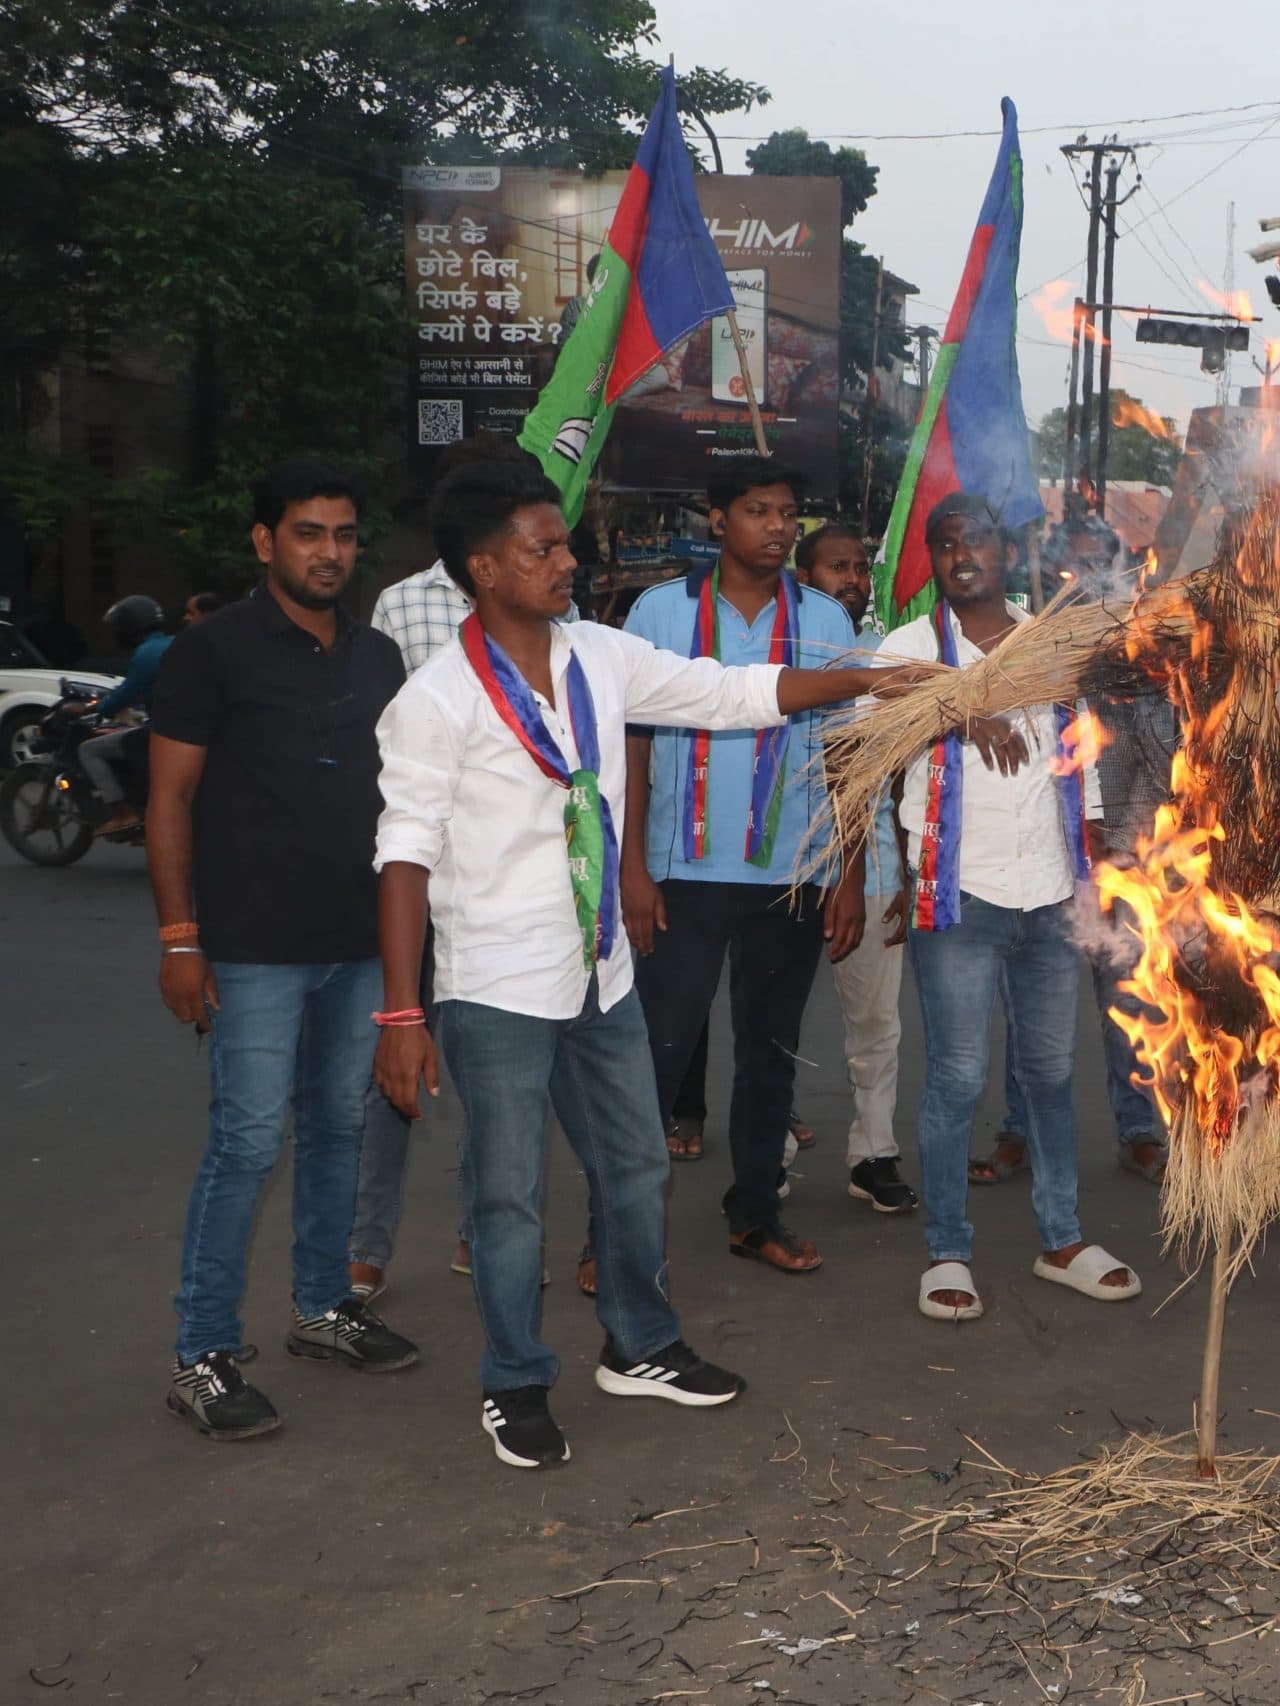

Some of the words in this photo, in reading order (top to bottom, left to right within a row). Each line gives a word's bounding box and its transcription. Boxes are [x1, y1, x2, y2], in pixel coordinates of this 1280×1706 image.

[416, 225, 452, 244] घर
[460, 218, 488, 244] के
[704, 218, 800, 249] HIM
[416, 250, 463, 277] छोटे
[471, 250, 528, 282] बिल,
[416, 282, 478, 309] सिर्फ
[485, 283, 522, 314] बड़े
[418, 315, 466, 342] क्यों
[472, 315, 493, 342] पे
[420, 360, 447, 369] BHIM
[474, 358, 511, 370] आसानी
[514, 359, 524, 370] से
[482, 372, 502, 384] बिल
[489, 407, 529, 416] Download
